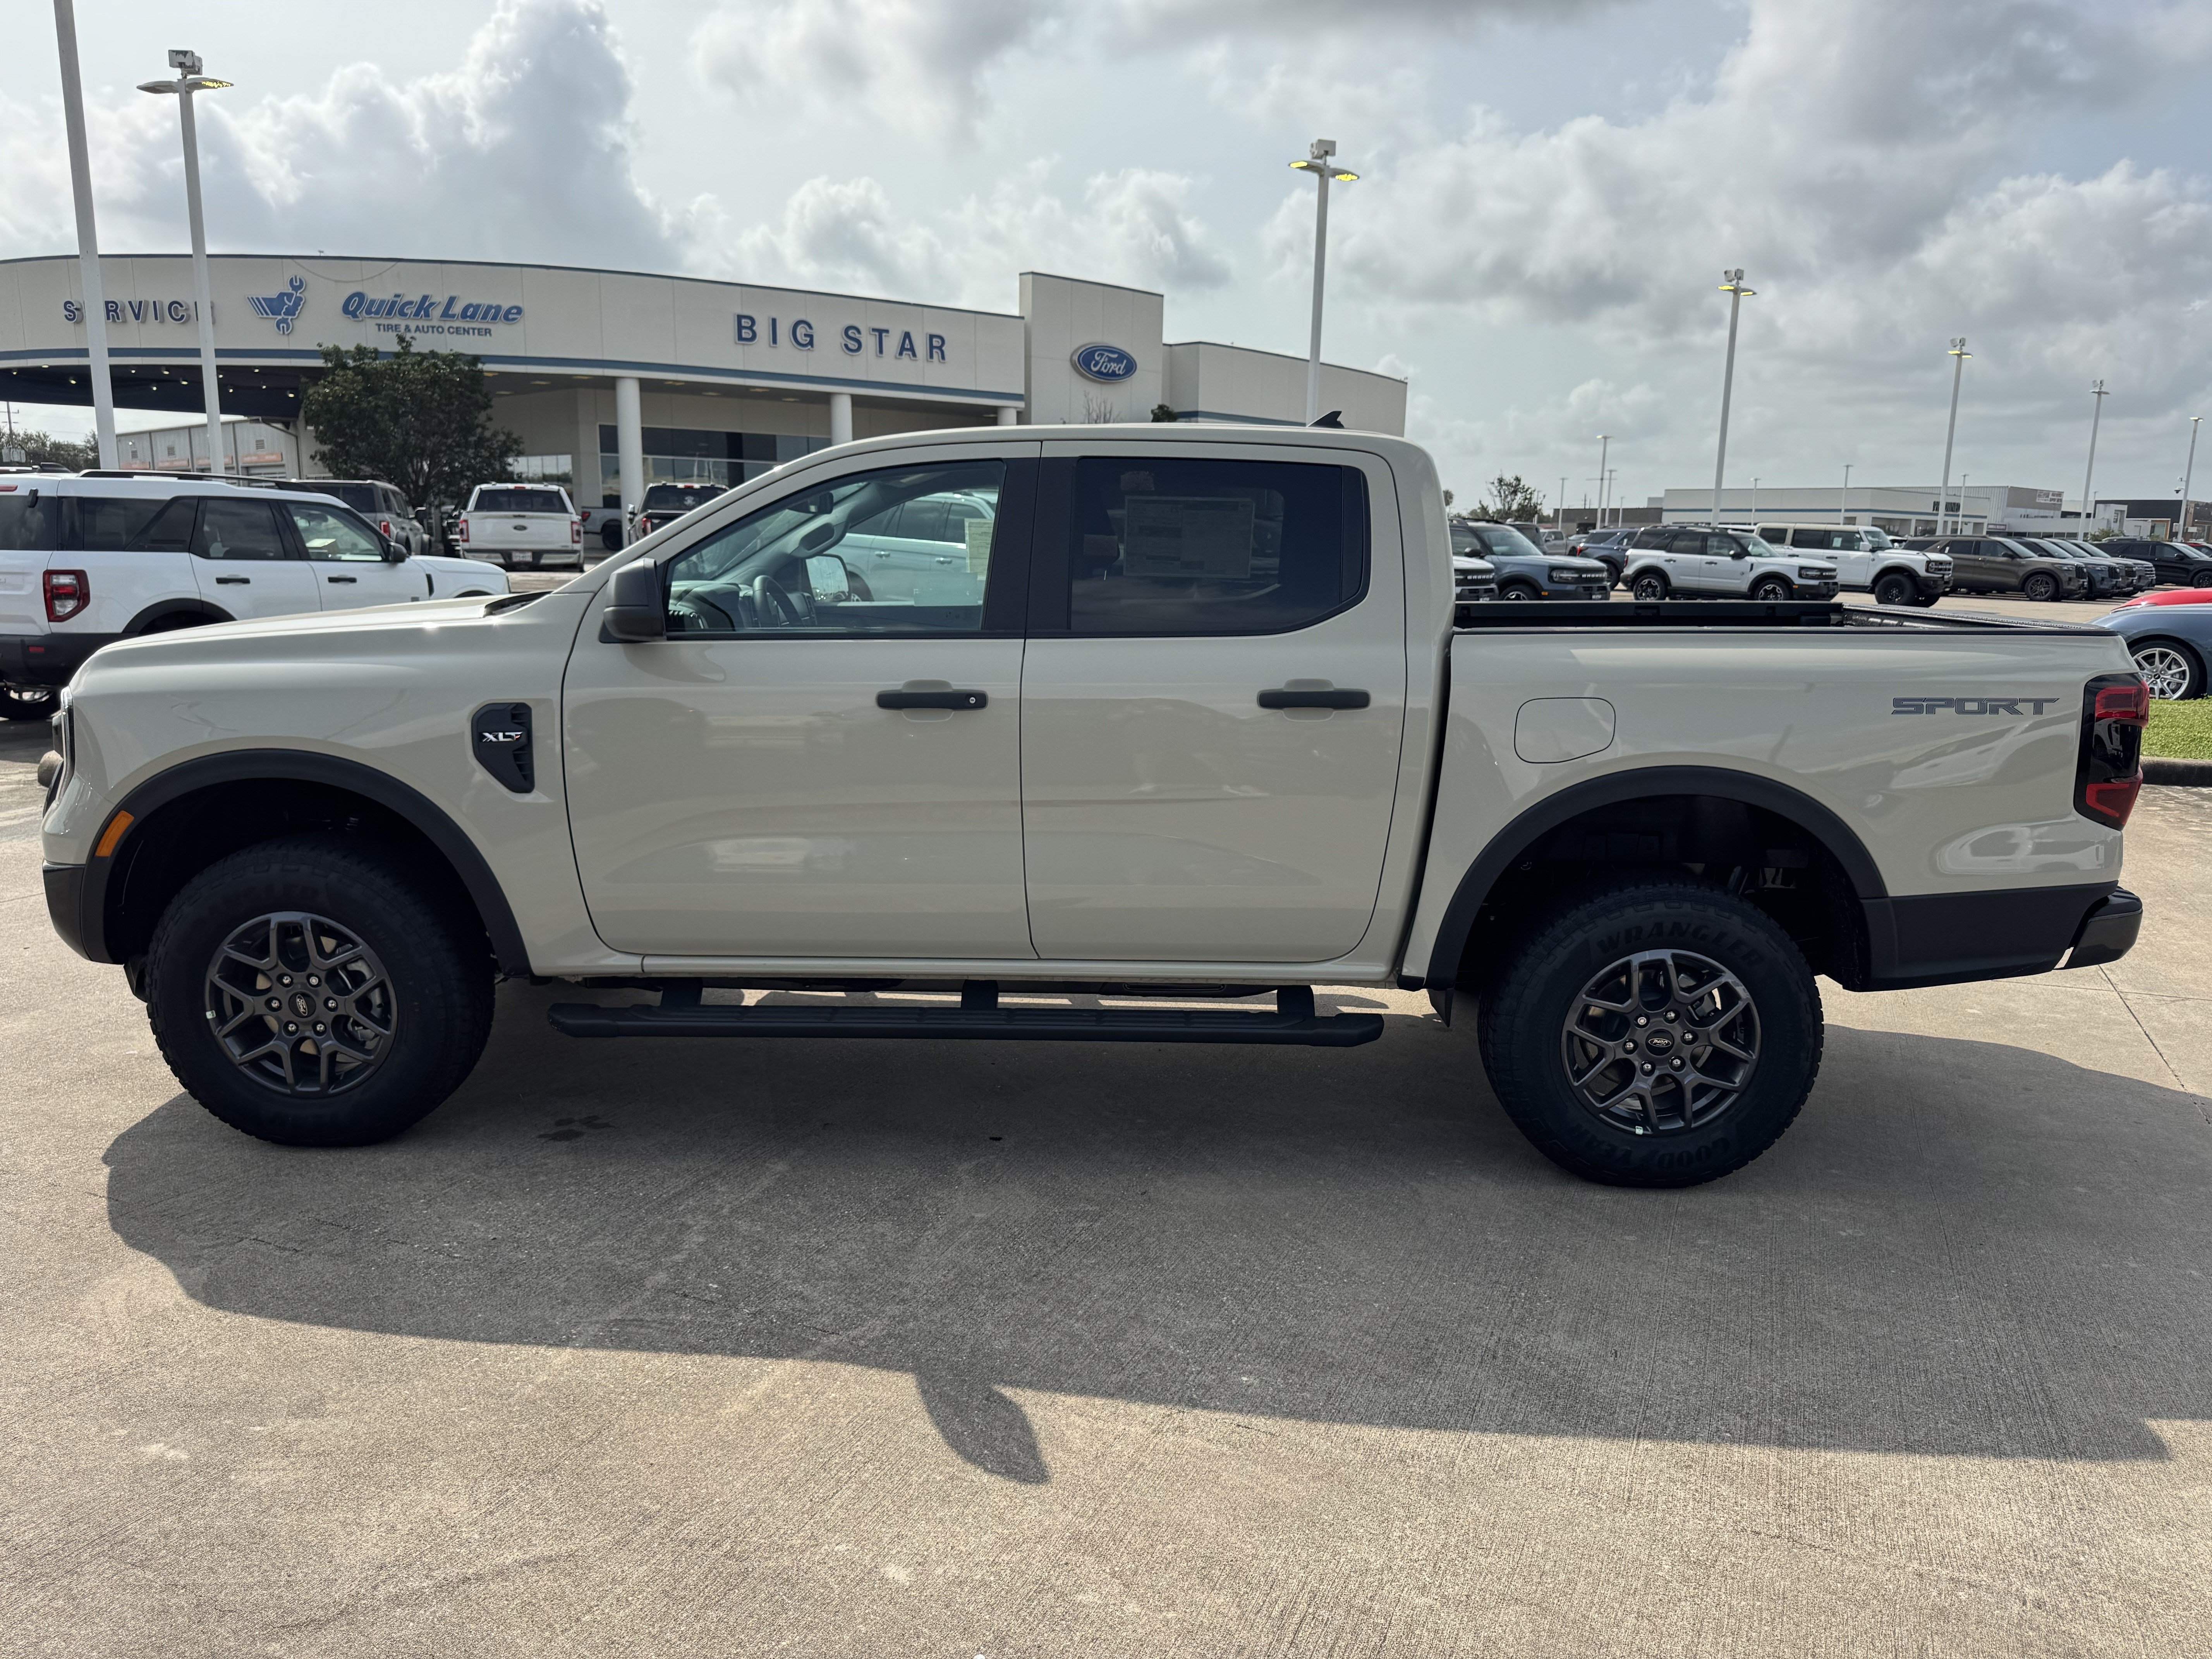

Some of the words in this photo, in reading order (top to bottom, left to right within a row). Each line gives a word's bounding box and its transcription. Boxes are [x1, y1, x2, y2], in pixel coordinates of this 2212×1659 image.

[63, 300, 207, 324] SRVIC
[342, 291, 439, 321] Quick
[439, 295, 524, 324] Lane
[376, 323, 401, 334] TIRE
[404, 324, 411, 334] &
[414, 325, 445, 335] AUTO
[447, 327, 492, 337] CENTER
[736, 314, 814, 350] BIG
[843, 325, 946, 362] STAR
[1091, 350, 1127, 375] Ford
[1891, 697, 2060, 715] SPORT
[482, 732, 523, 742] XLT
[1595, 922, 1764, 968] WRANGLER
